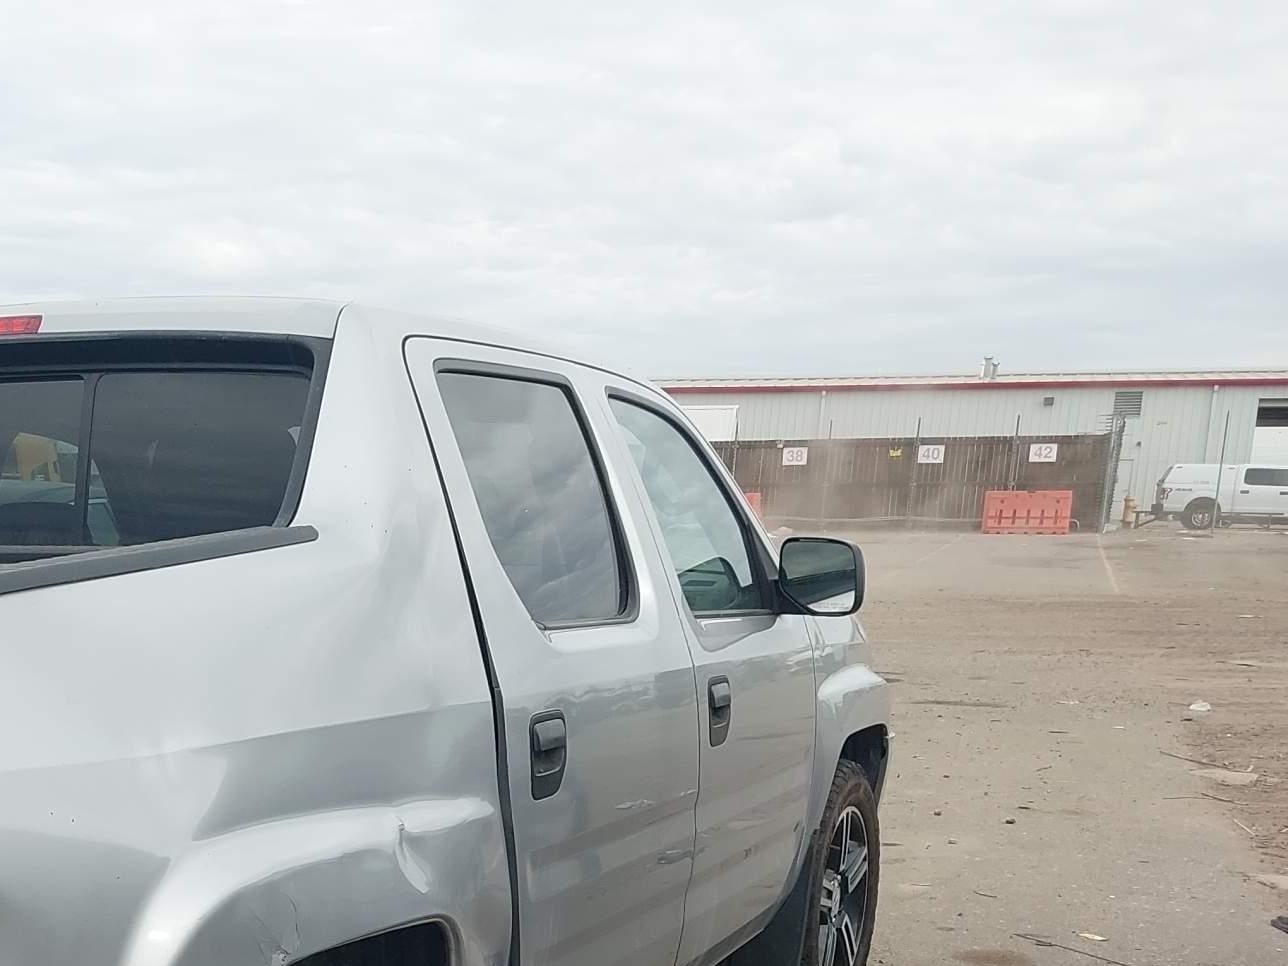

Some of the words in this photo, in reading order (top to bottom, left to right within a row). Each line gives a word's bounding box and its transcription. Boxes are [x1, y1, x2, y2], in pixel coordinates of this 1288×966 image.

[786, 449, 804, 463] 38
[922, 446, 941, 460] 40
[1033, 445, 1054, 459] 42
